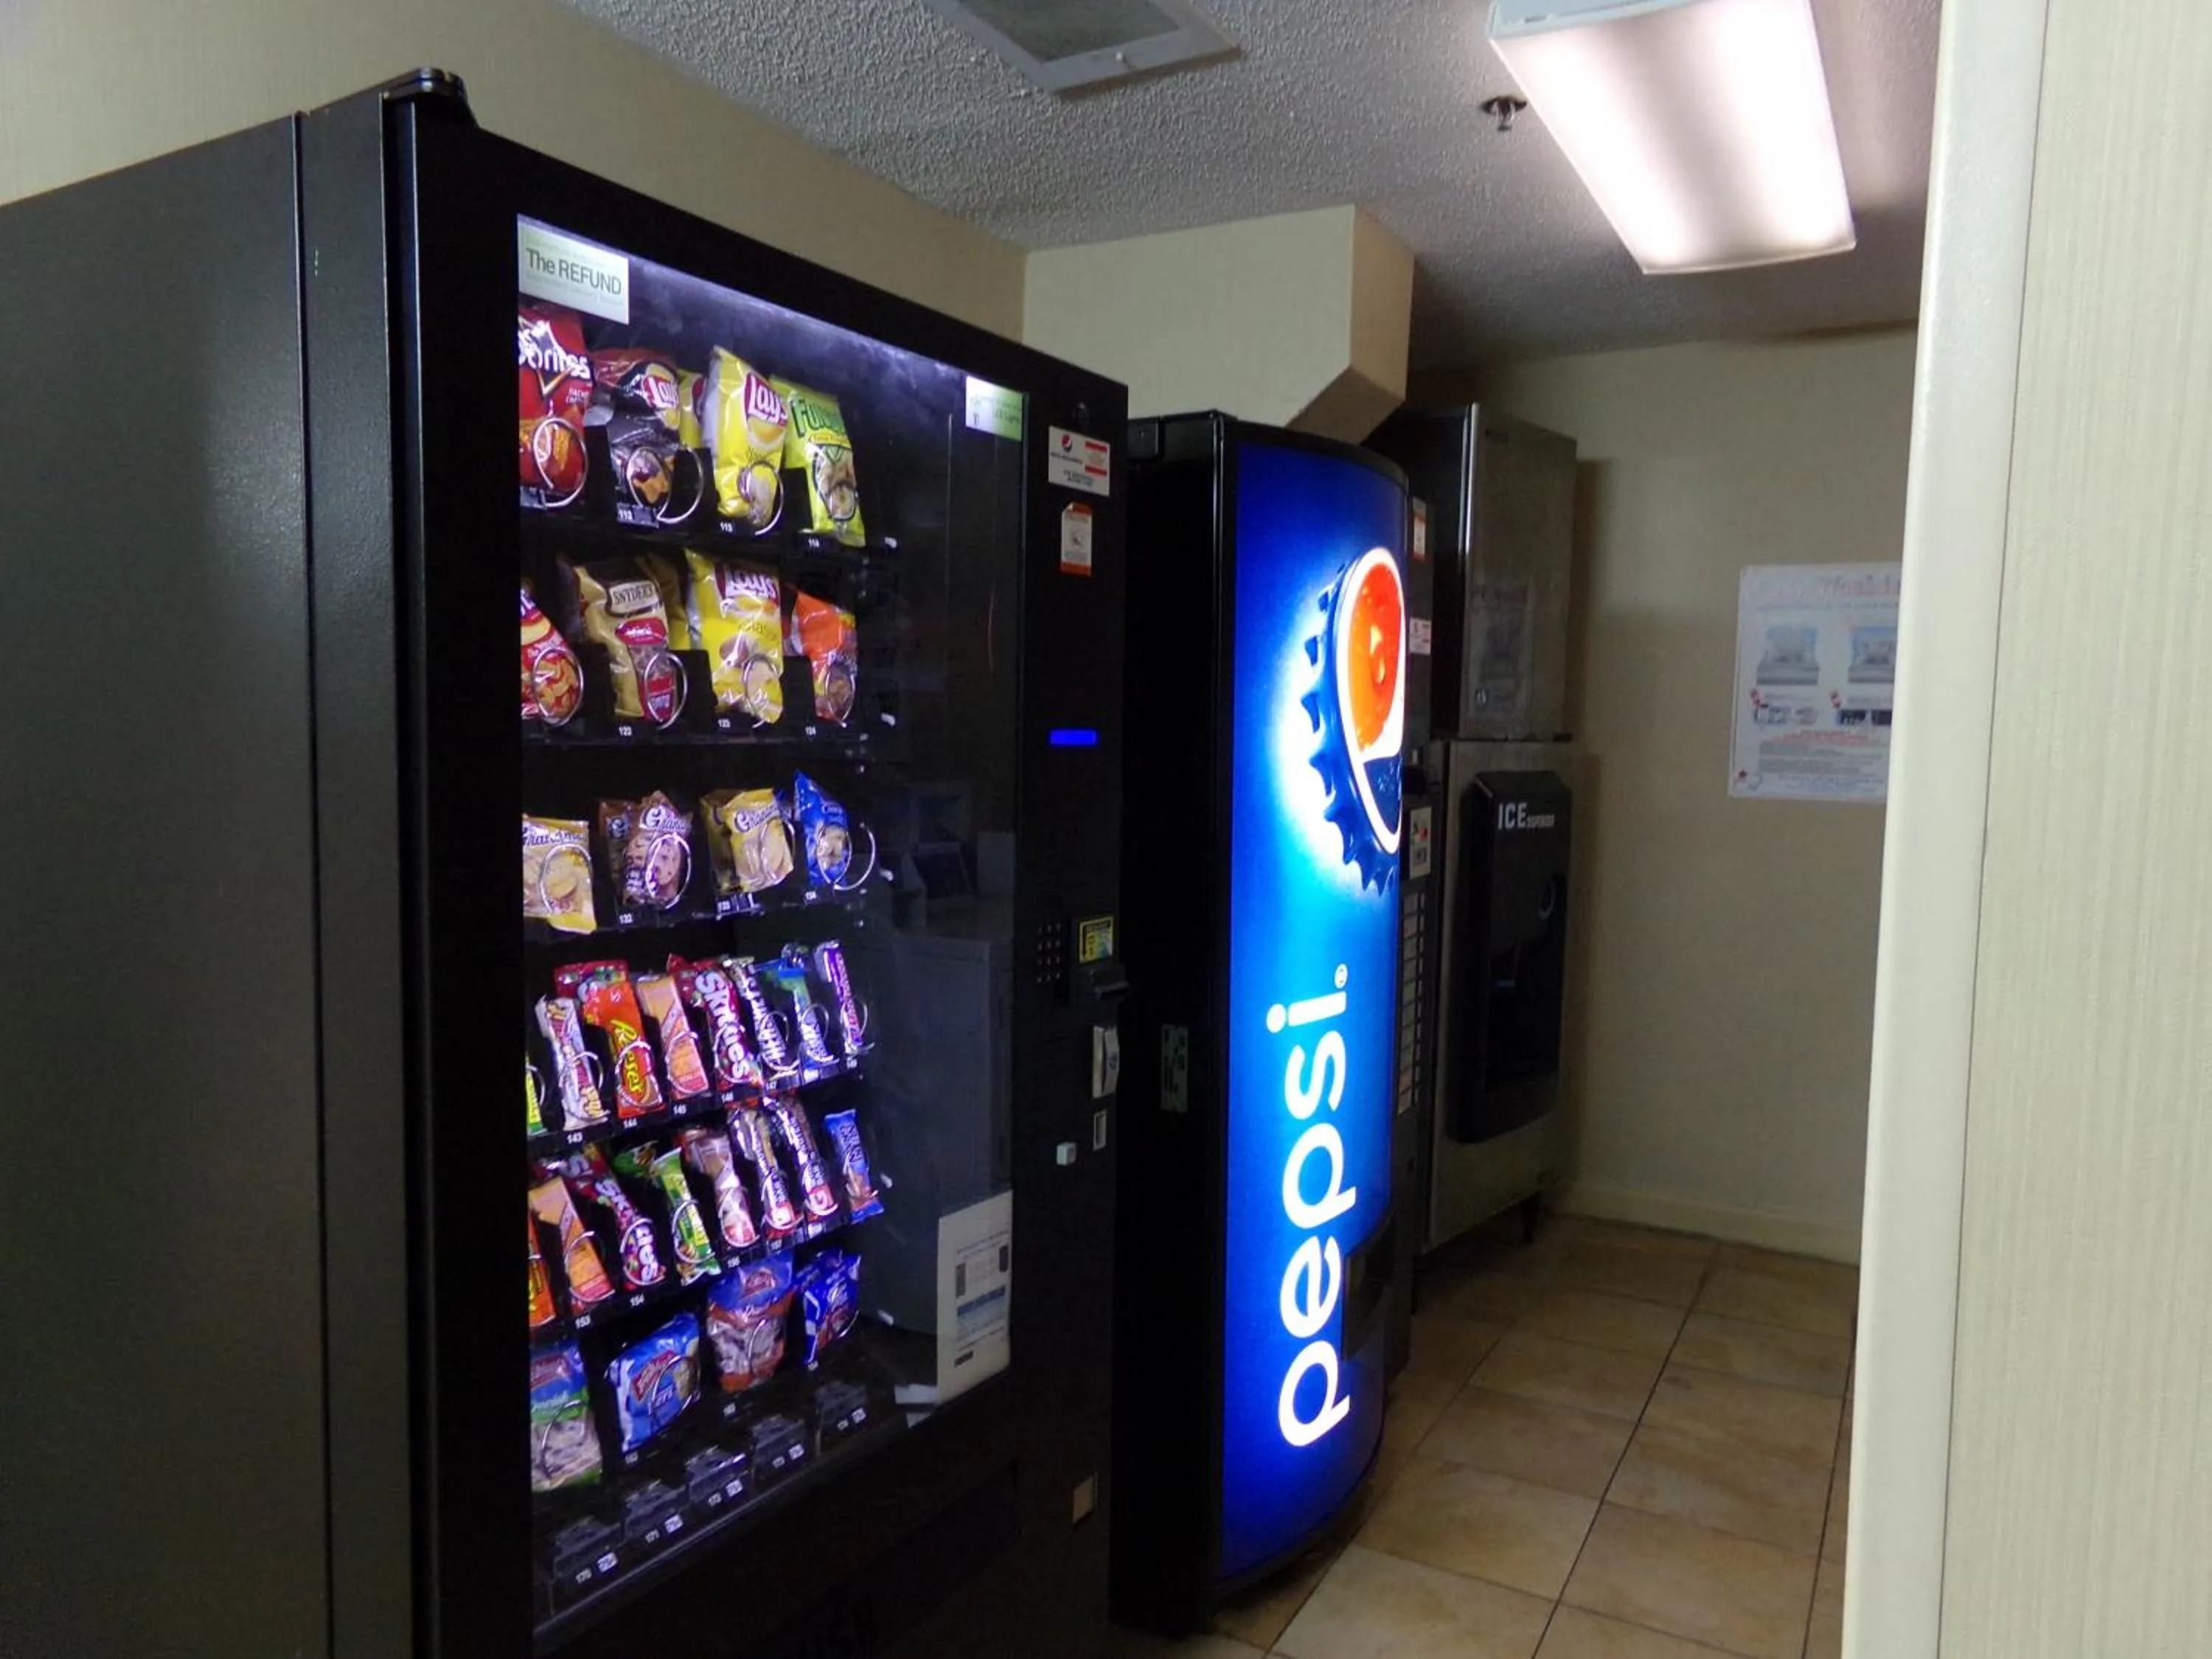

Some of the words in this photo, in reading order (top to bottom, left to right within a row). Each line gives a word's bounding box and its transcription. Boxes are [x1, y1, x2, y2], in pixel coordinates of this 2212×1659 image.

[526, 247, 555, 274] The
[558, 259, 622, 295] REFUND
[1498, 801, 1527, 830] ICE
[1266, 990, 1356, 1447] pepsi
